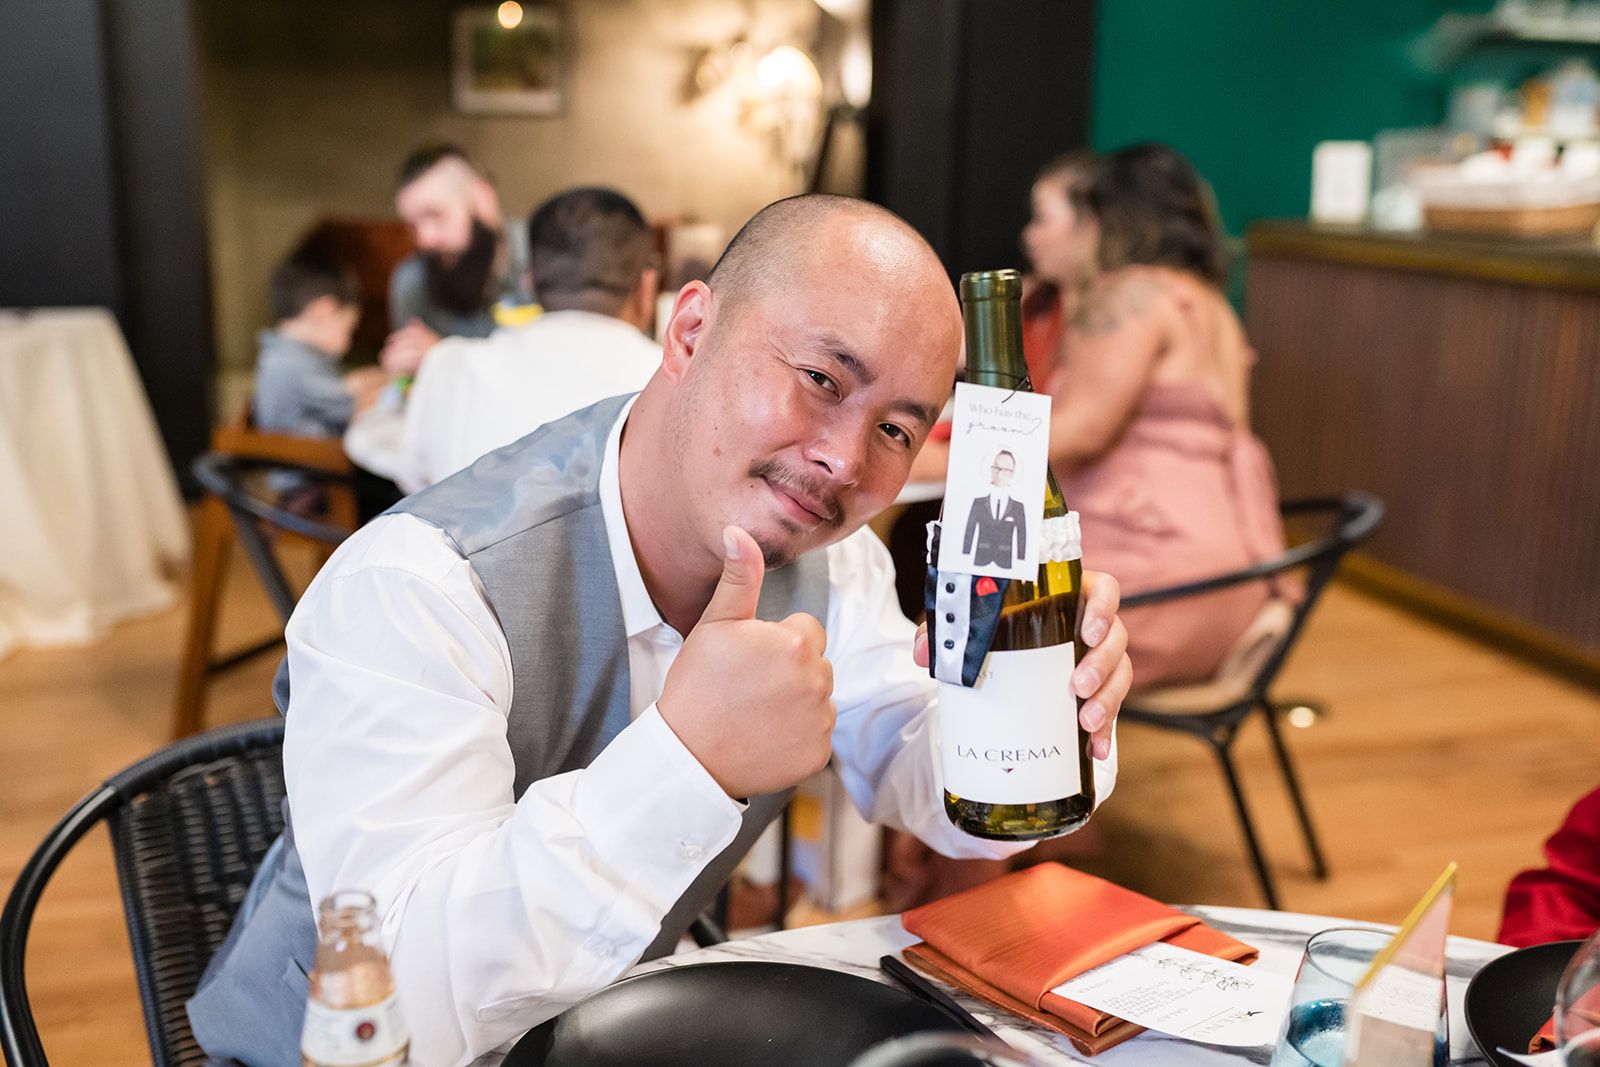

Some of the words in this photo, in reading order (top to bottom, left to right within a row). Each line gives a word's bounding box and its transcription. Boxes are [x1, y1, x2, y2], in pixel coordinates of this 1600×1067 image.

[968, 402, 993, 414] Who
[994, 405, 1013, 417] has
[1014, 409, 1031, 421] the
[957, 744, 978, 760] LA
[984, 745, 1061, 762] CREMA
[1188, 1012, 1248, 1036] MENU
